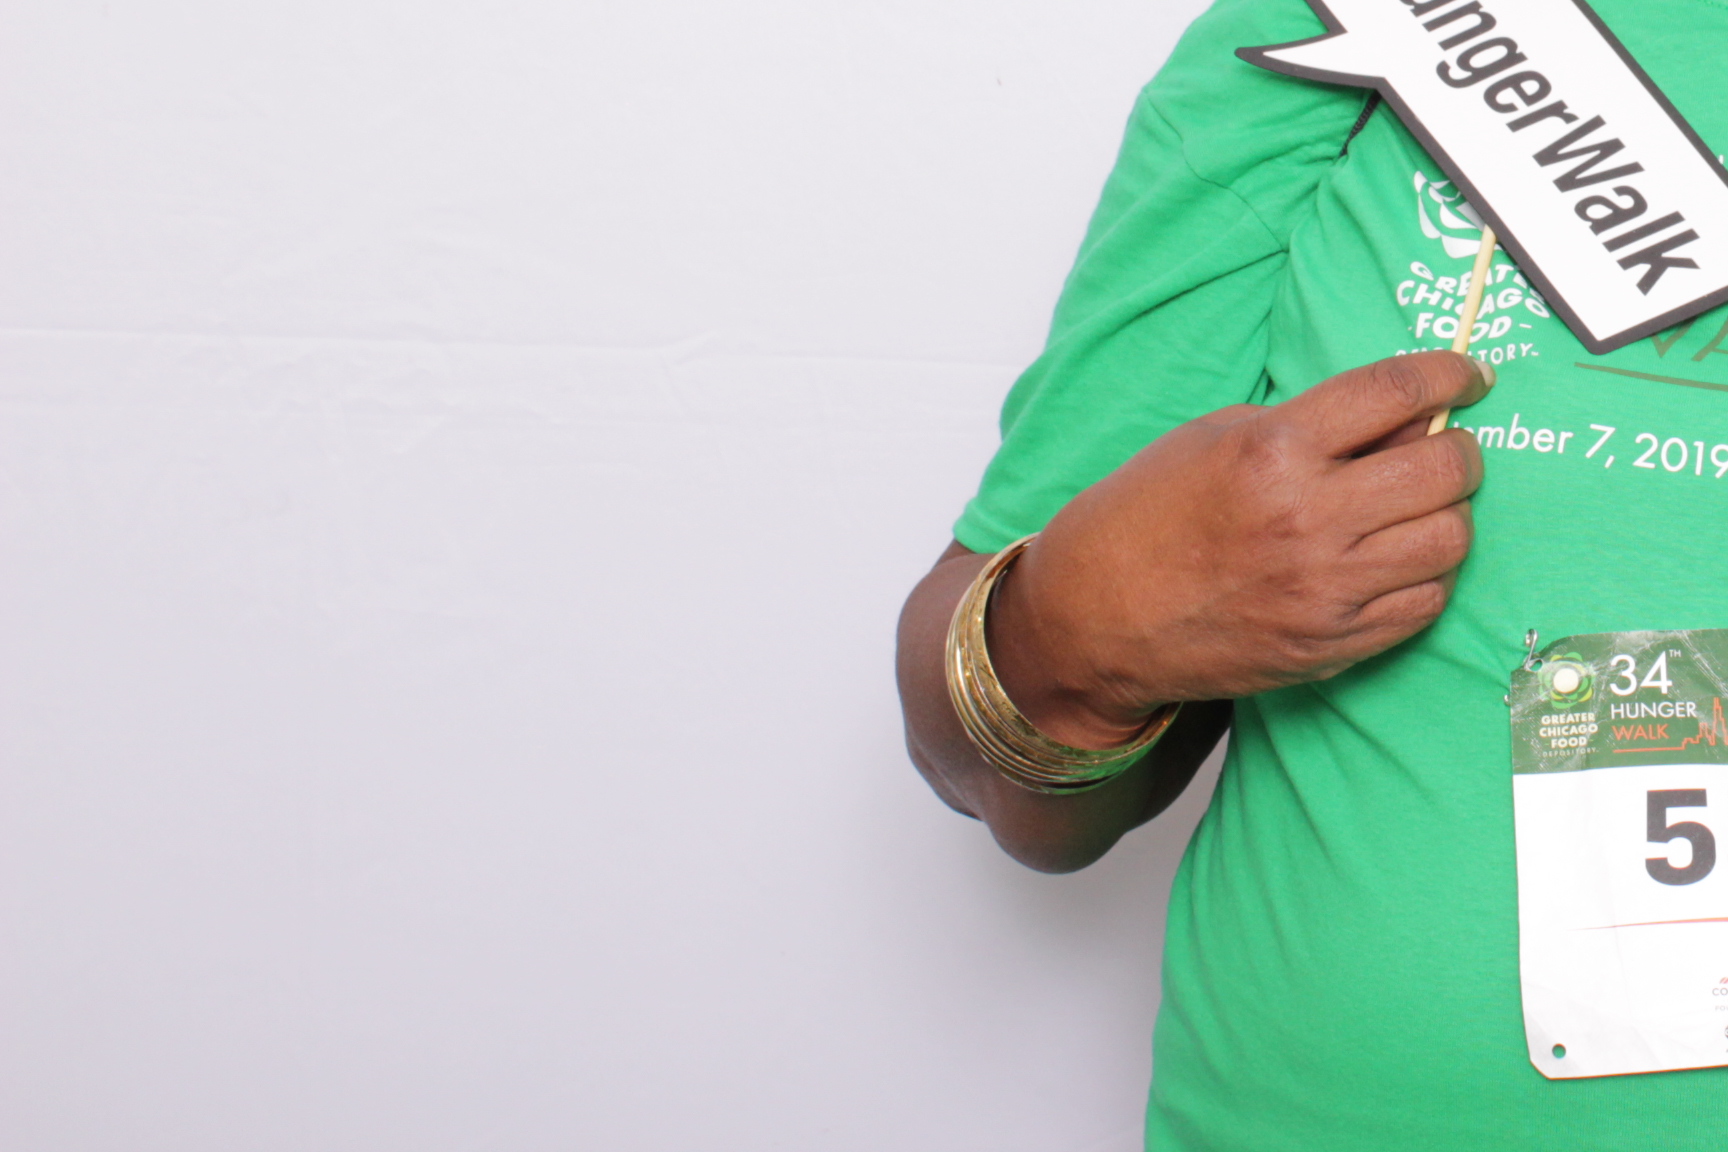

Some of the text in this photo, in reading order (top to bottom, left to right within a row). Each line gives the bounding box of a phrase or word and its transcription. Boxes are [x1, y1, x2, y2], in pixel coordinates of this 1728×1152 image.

[1585, 424, 1615, 469] 7,
[1541, 711, 1596, 725] GREATER
[1610, 700, 1697, 720] HUNGER
[1539, 723, 1598, 737] CHICAGO
[1611, 723, 1669, 741] WALK
[1550, 736, 1588, 749] FOOD
